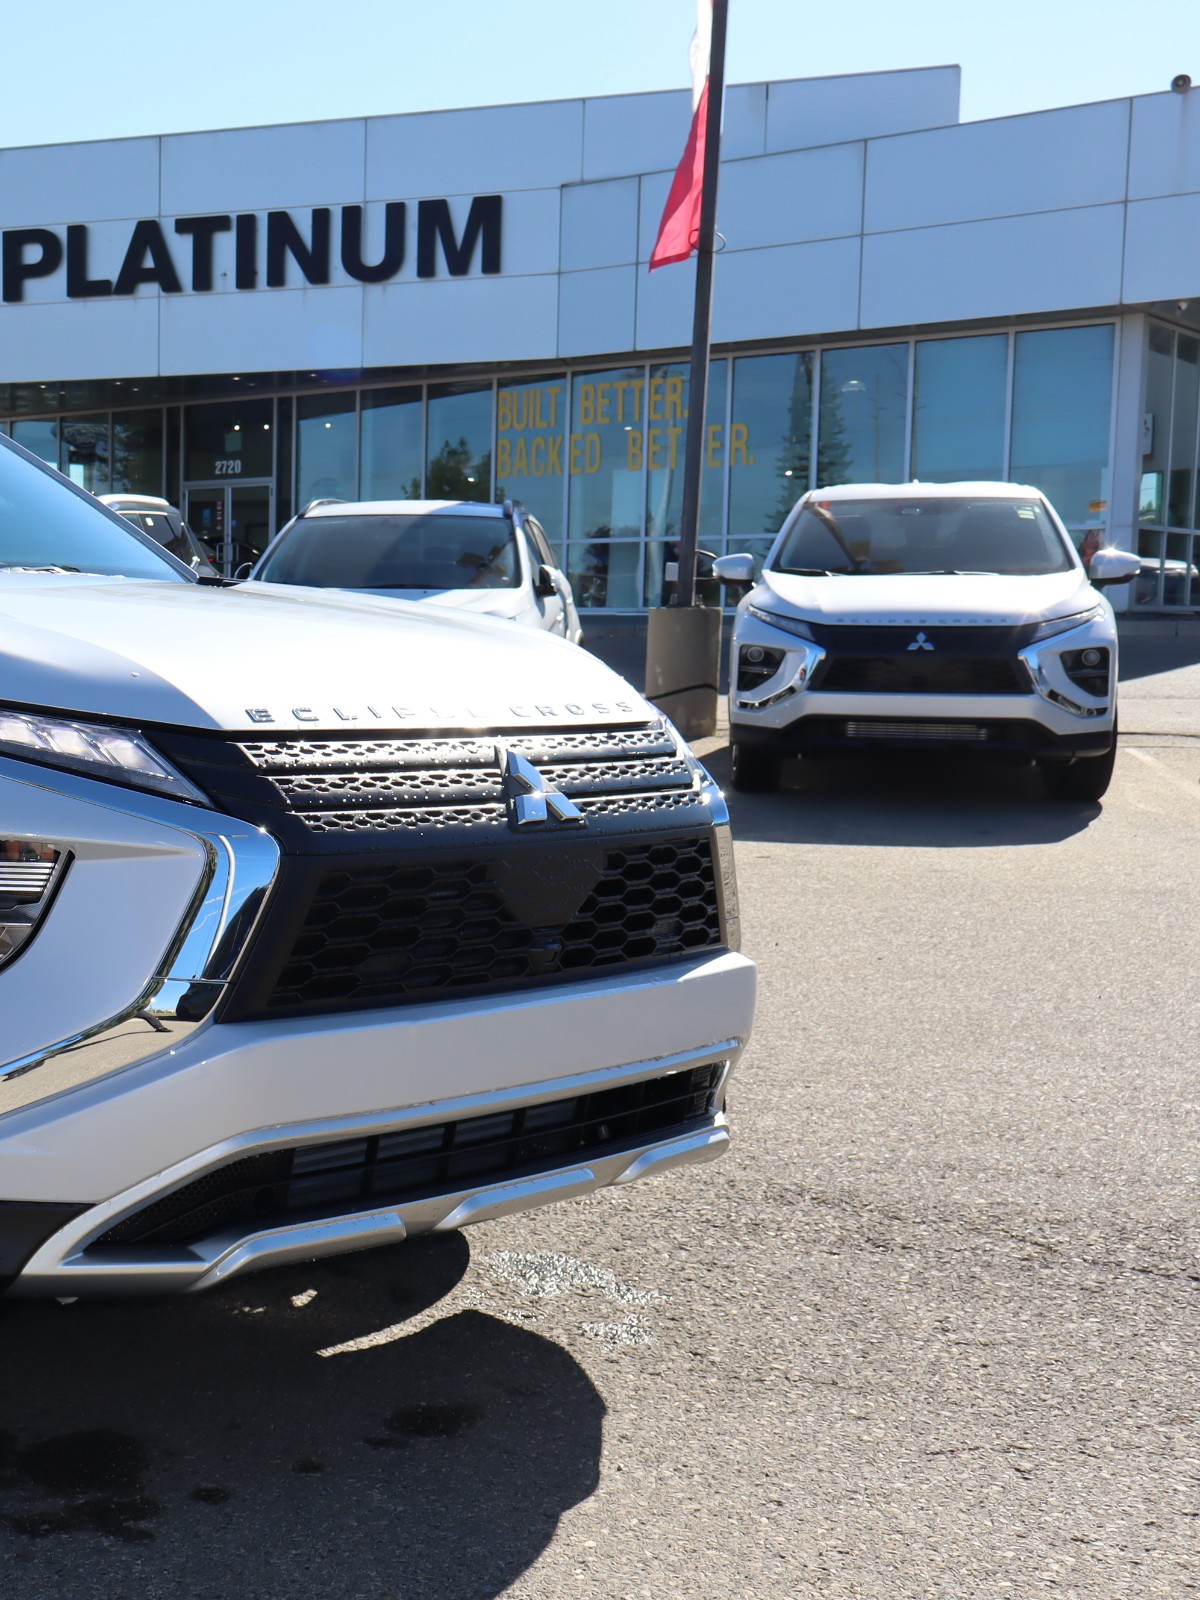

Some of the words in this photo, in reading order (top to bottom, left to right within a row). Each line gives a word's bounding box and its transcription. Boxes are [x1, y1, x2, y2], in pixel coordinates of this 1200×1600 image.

[2, 194, 503, 303] PLATINUM
[498, 386, 561, 431] BUILT
[580, 376, 690, 426] BETTER.
[214, 459, 242, 475] 2720
[497, 432, 601, 479] BACKED
[627, 422, 756, 472] BETER.
[508, 701, 634, 717] CROSS
